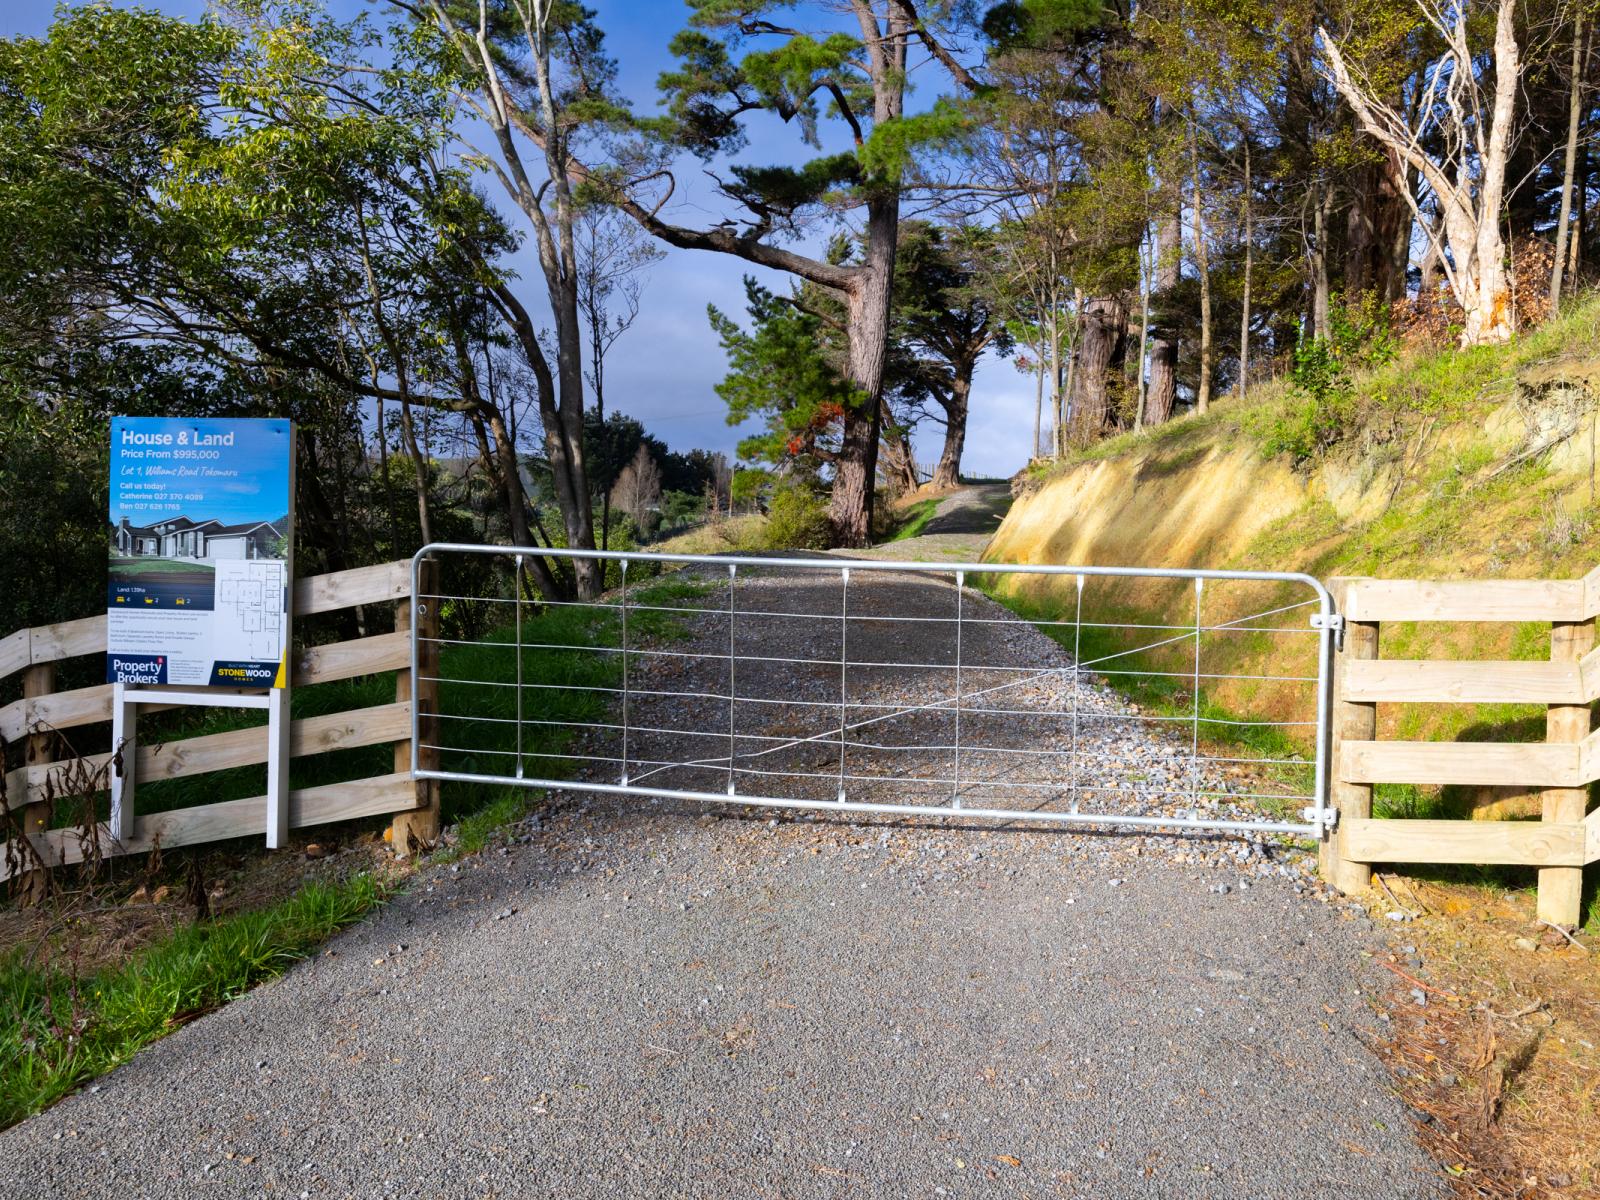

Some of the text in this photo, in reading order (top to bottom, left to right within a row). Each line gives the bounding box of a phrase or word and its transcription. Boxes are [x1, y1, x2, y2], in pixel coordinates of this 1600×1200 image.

[122, 430, 234, 446] House & Land
[121, 449, 220, 460] Price From $995,000
[120, 464, 134, 476] Lot
[177, 466, 198, 477] Road
[144, 483, 166, 491] today!
[113, 659, 162, 674] Property
[218, 668, 272, 677] STONEWOOD
[117, 672, 158, 684] Brokers
